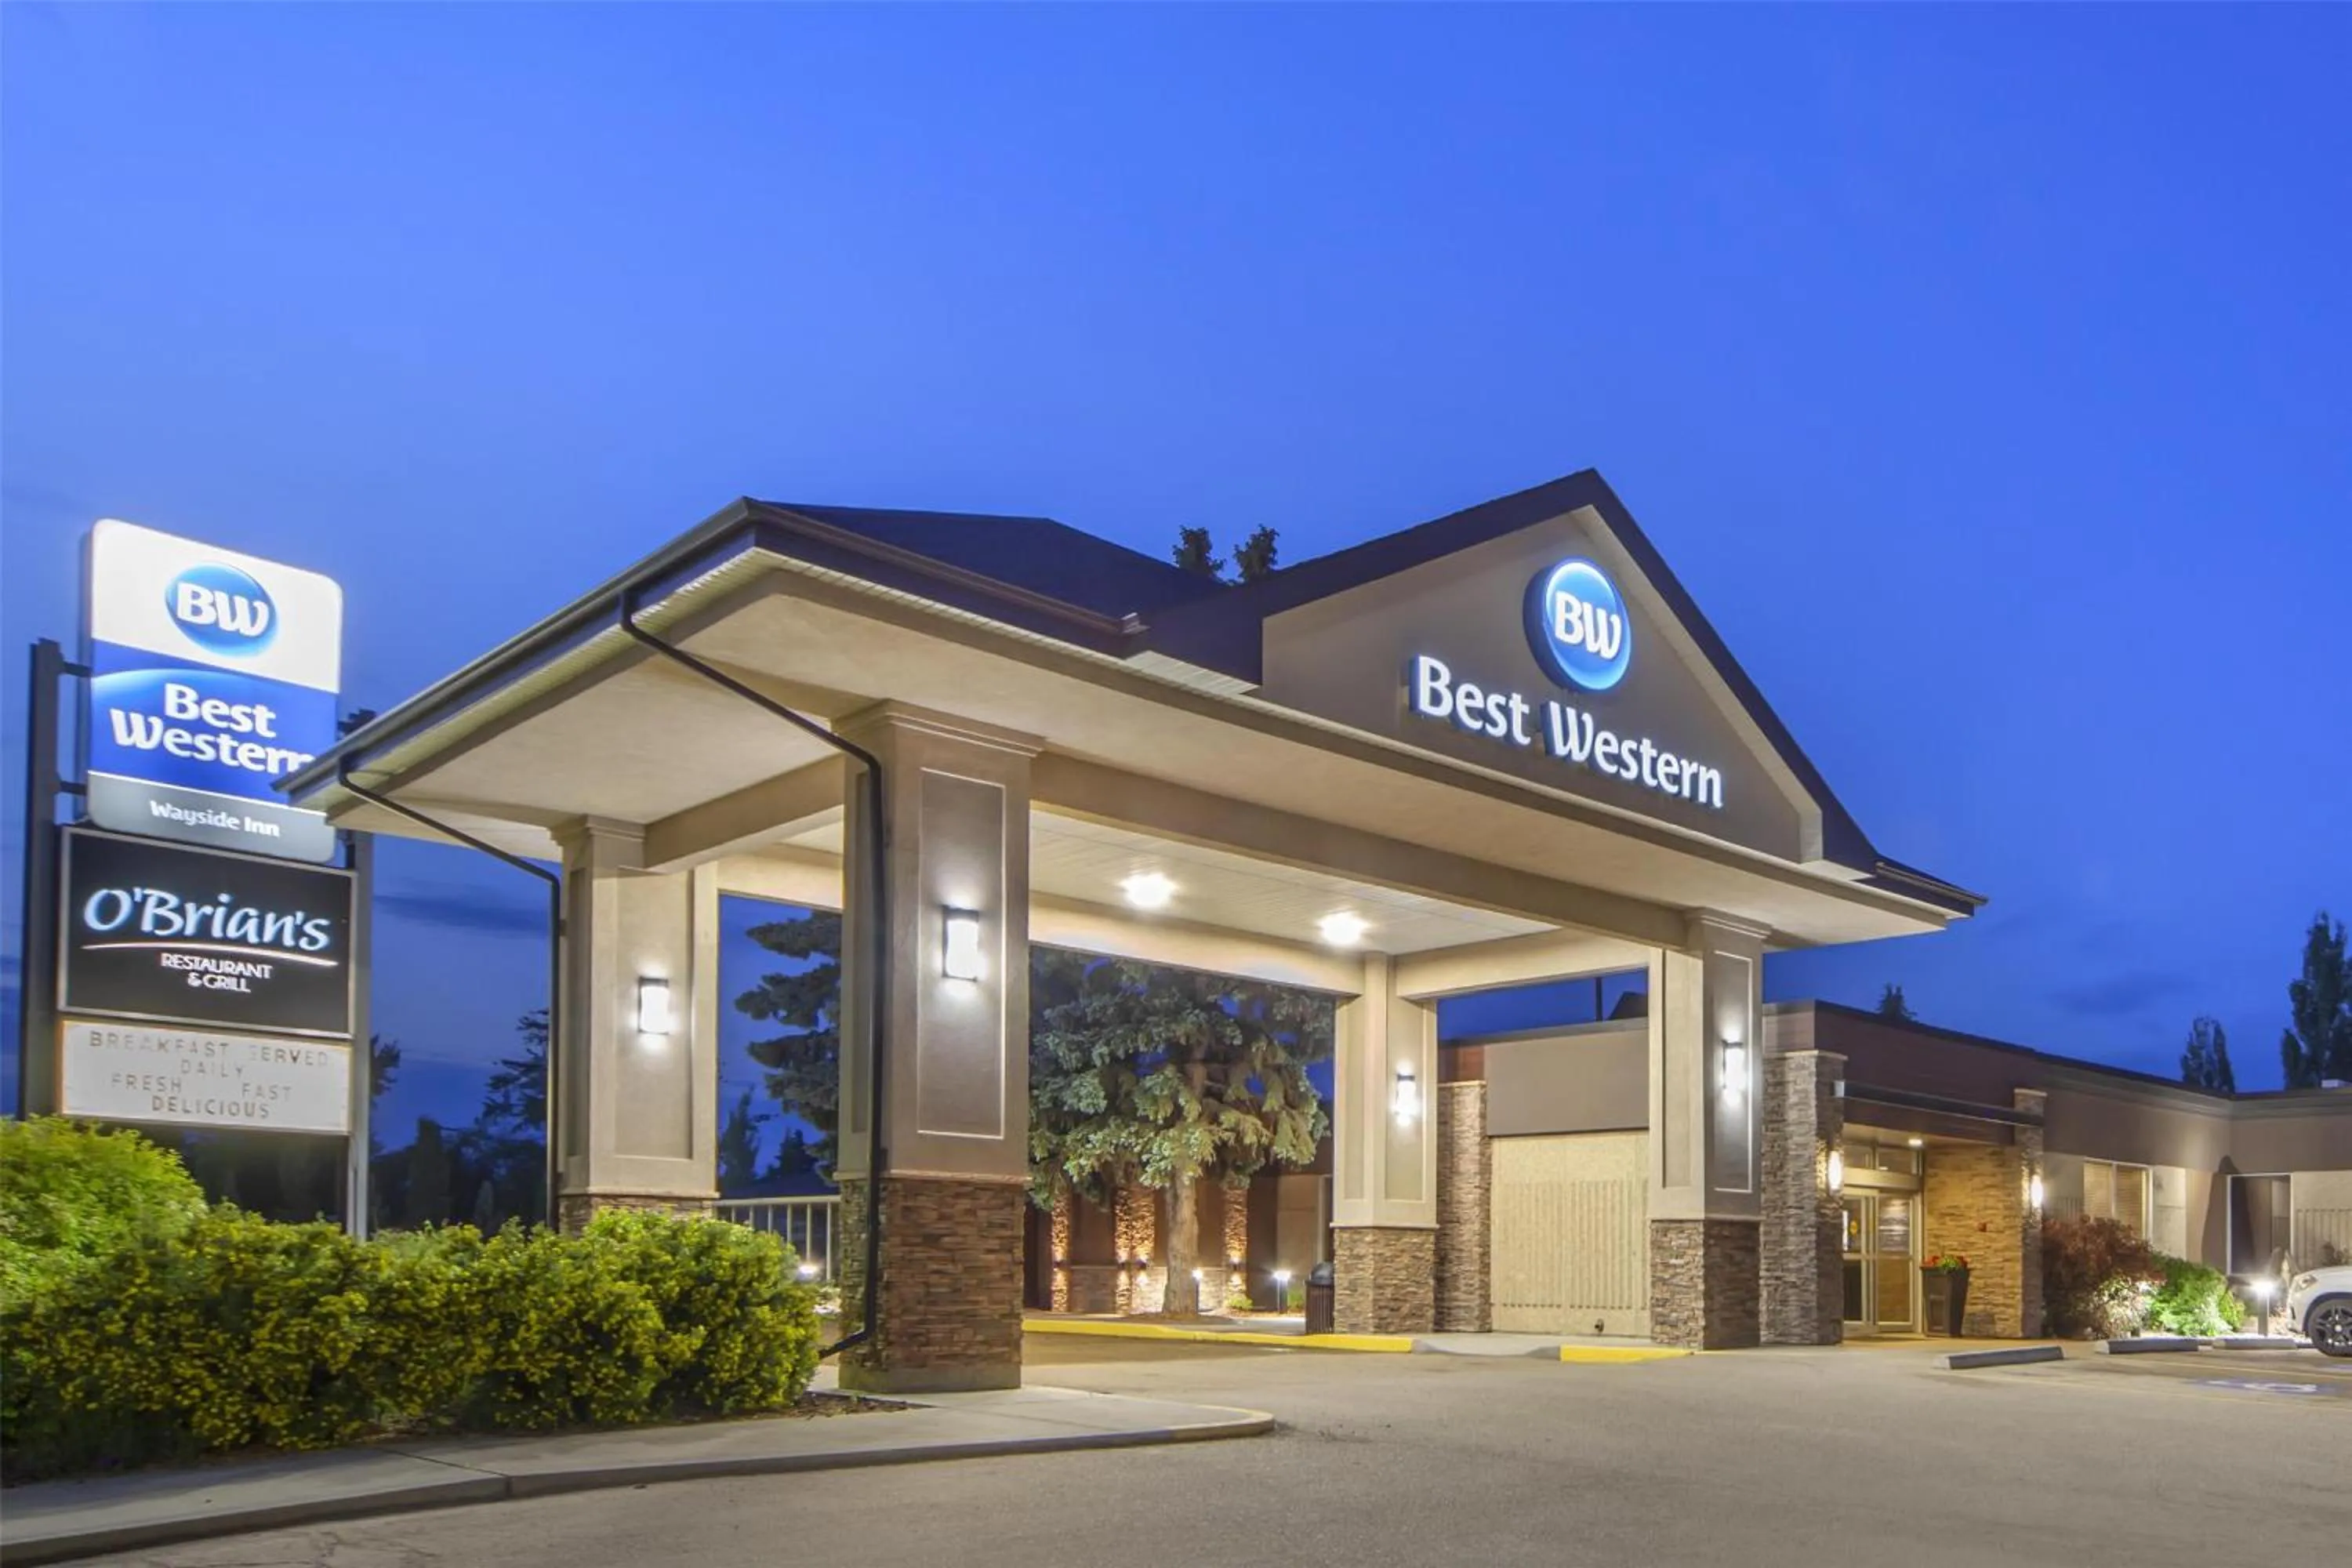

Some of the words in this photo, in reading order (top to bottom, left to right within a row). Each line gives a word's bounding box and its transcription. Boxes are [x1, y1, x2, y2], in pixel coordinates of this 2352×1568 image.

[176, 583, 269, 637] BW
[1555, 590, 1622, 659] BW
[165, 683, 276, 738] Best
[1417, 654, 1531, 746] Best
[1547, 700, 1724, 808] Western
[150, 800, 240, 832] Wayside
[244, 816, 281, 837] Inn
[84, 887, 331, 951] O'Brian's
[161, 953, 274, 979] RESTAURANT
[89, 1029, 230, 1058] BREAKFAST
[180, 1058, 245, 1078] DAILY
[111, 1072, 182, 1094] FRESH
[241, 1082, 292, 1102] FAST
[151, 1094, 270, 1120] DELICIOUS
